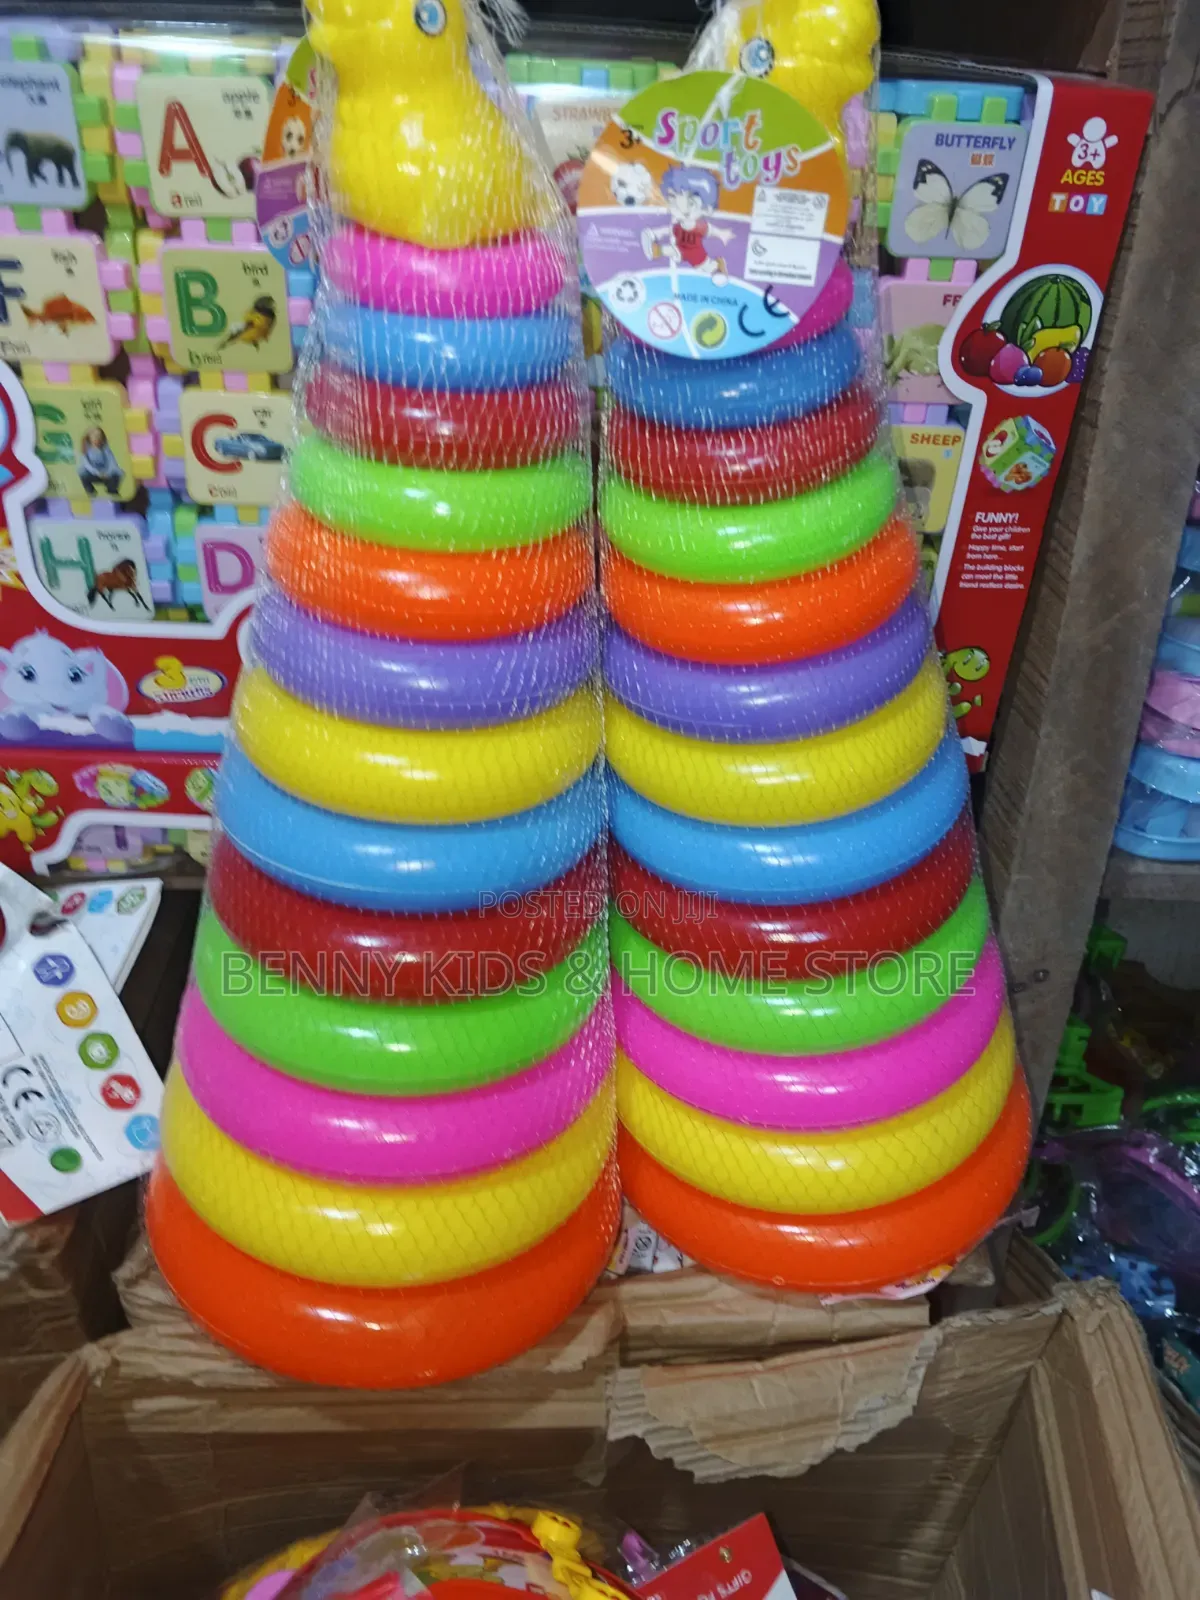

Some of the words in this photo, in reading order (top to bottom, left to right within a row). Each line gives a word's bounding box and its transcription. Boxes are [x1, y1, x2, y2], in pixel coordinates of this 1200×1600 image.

[158, 99, 212, 178] A
[657, 110, 761, 158] Sport
[935, 132, 1016, 150] BUTTERFLY
[725, 145, 799, 185] toys
[1078, 144, 1101, 160] 3+
[1060, 169, 1105, 187] AGES
[1051, 194, 1106, 214] TOY
[174, 268, 228, 337] B
[711, 296, 738, 306] CHINA
[191, 414, 243, 474] C
[910, 433, 962, 446] SHEEP
[975, 512, 1019, 523] FUNNY!
[40, 536, 95, 590] H
[203, 540, 256, 594] D
[154, 655, 187, 690] 3
